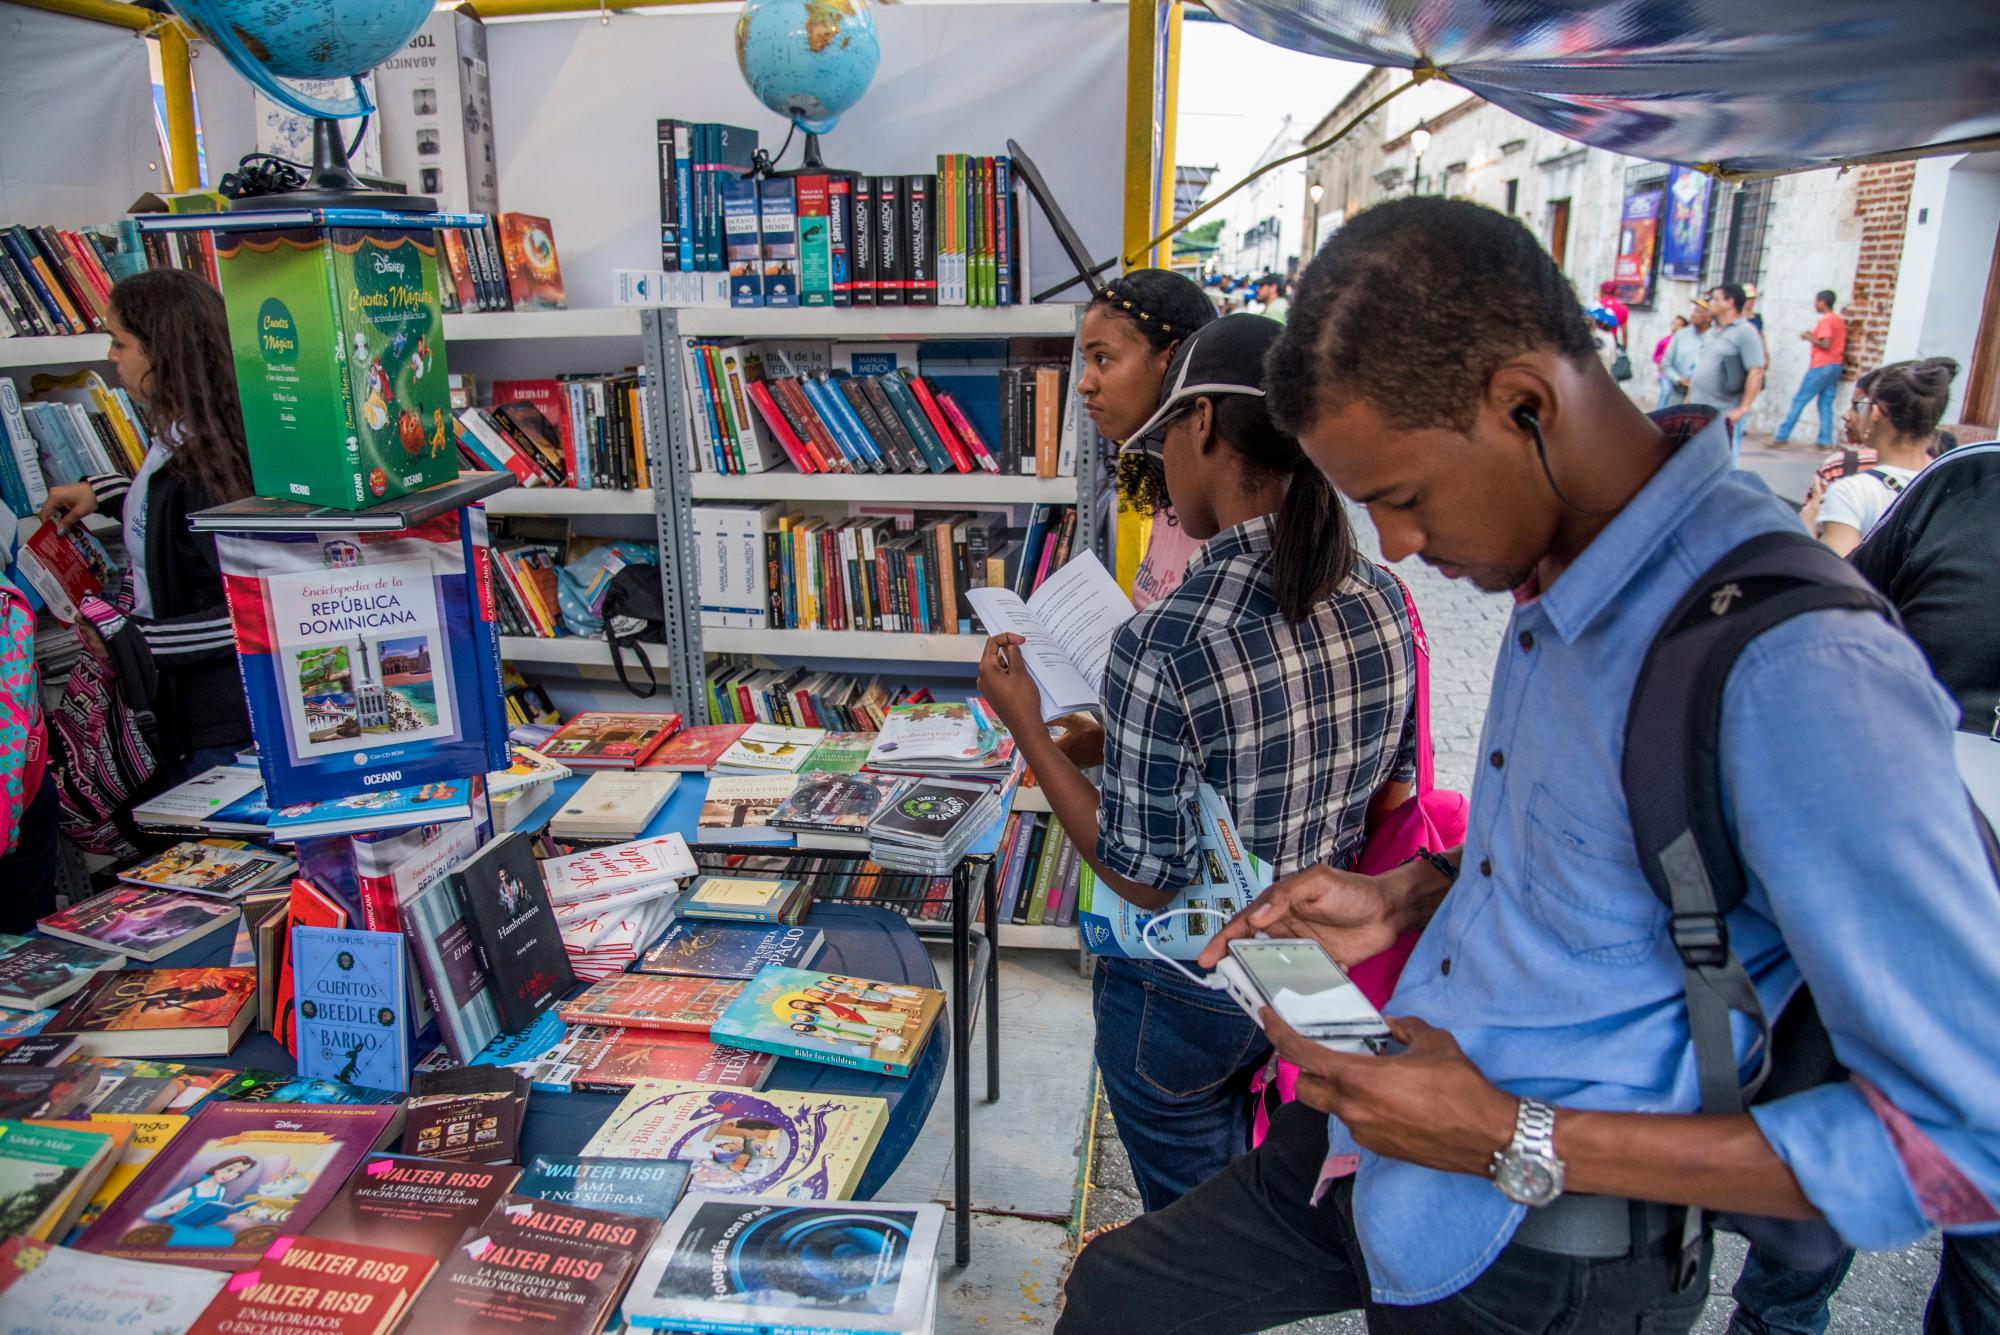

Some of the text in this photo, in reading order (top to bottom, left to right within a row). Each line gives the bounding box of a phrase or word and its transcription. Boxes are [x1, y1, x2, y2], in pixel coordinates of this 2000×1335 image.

[385, 57, 437, 70] ABANICO
[831, 199, 842, 242] SÍNTOMAS
[857, 201, 866, 269] MANUAL MERCK
[882, 201, 892, 269] MANUAL MERCK
[912, 201, 923, 269] MANUAL MERCK
[371, 252, 405, 280] Disney
[348, 288, 388, 311] Cuentos
[858, 356, 889, 364] MANUAL
[858, 364, 890, 374] MERCK
[513, 388, 550, 400] ASESINATO
[354, 473, 364, 502] OCEANO
[404, 472, 423, 487] OCEANO
[480, 549, 488, 561] 2
[302, 576, 403, 598] Enciclopedia de la
[482, 564, 492, 611] DOMINICANA
[718, 564, 726, 593] MANUAL
[311, 594, 401, 618] REPÚBLICA
[300, 610, 416, 636] DOMINICANA
[382, 749, 405, 759] CD-ROM
[363, 770, 402, 786] OCEANO
[1016, 824, 1030, 857] TIENDAS
[1036, 856, 1052, 898] PAISAJISMO
[1232, 862, 1256, 907] ESTAMO
[497, 905, 540, 939] Hambrientos
[454, 950, 461, 961] El
[768, 928, 804, 967] SPACIO
[317, 979, 378, 999] CUENTOS
[319, 1005, 378, 1024] BEEDLE
[320, 1028, 377, 1051] BARDO
[717, 1048, 754, 1083] TIEM
[794, 1049, 857, 1068] Bible for children
[436, 1113, 483, 1125] POSTRES
[677, 1093, 702, 1121] niños
[275, 1119, 303, 1130] Disney
[631, 1114, 666, 1146] Biblia
[376, 1164, 494, 1189] WALTER RISO
[545, 1163, 665, 1182] WALTER RISO
[355, 1188, 479, 1207] MUCHO MÁS QUE AMOR
[380, 1183, 466, 1198] LA FIDELIDAD ES
[539, 1190, 645, 1205] Y NO SUFRAS
[577, 1181, 614, 1192] AMA
[511, 1211, 587, 1238] WALTER
[588, 1221, 638, 1246] RISO
[472, 1244, 604, 1281] WALTER RISO
[710, 1204, 772, 1301] Fotografía con iPad
[281, 1248, 409, 1284] WALTER RISO
[450, 1274, 587, 1305] MUCHO MÁS QUE AMOR
[476, 1267, 572, 1291] LA FIDELIDAD ES
[238, 1283, 373, 1314] WALTER RISO
[218, 1320, 232, 1333] O
[236, 1307, 343, 1329] ENAMORADOS
